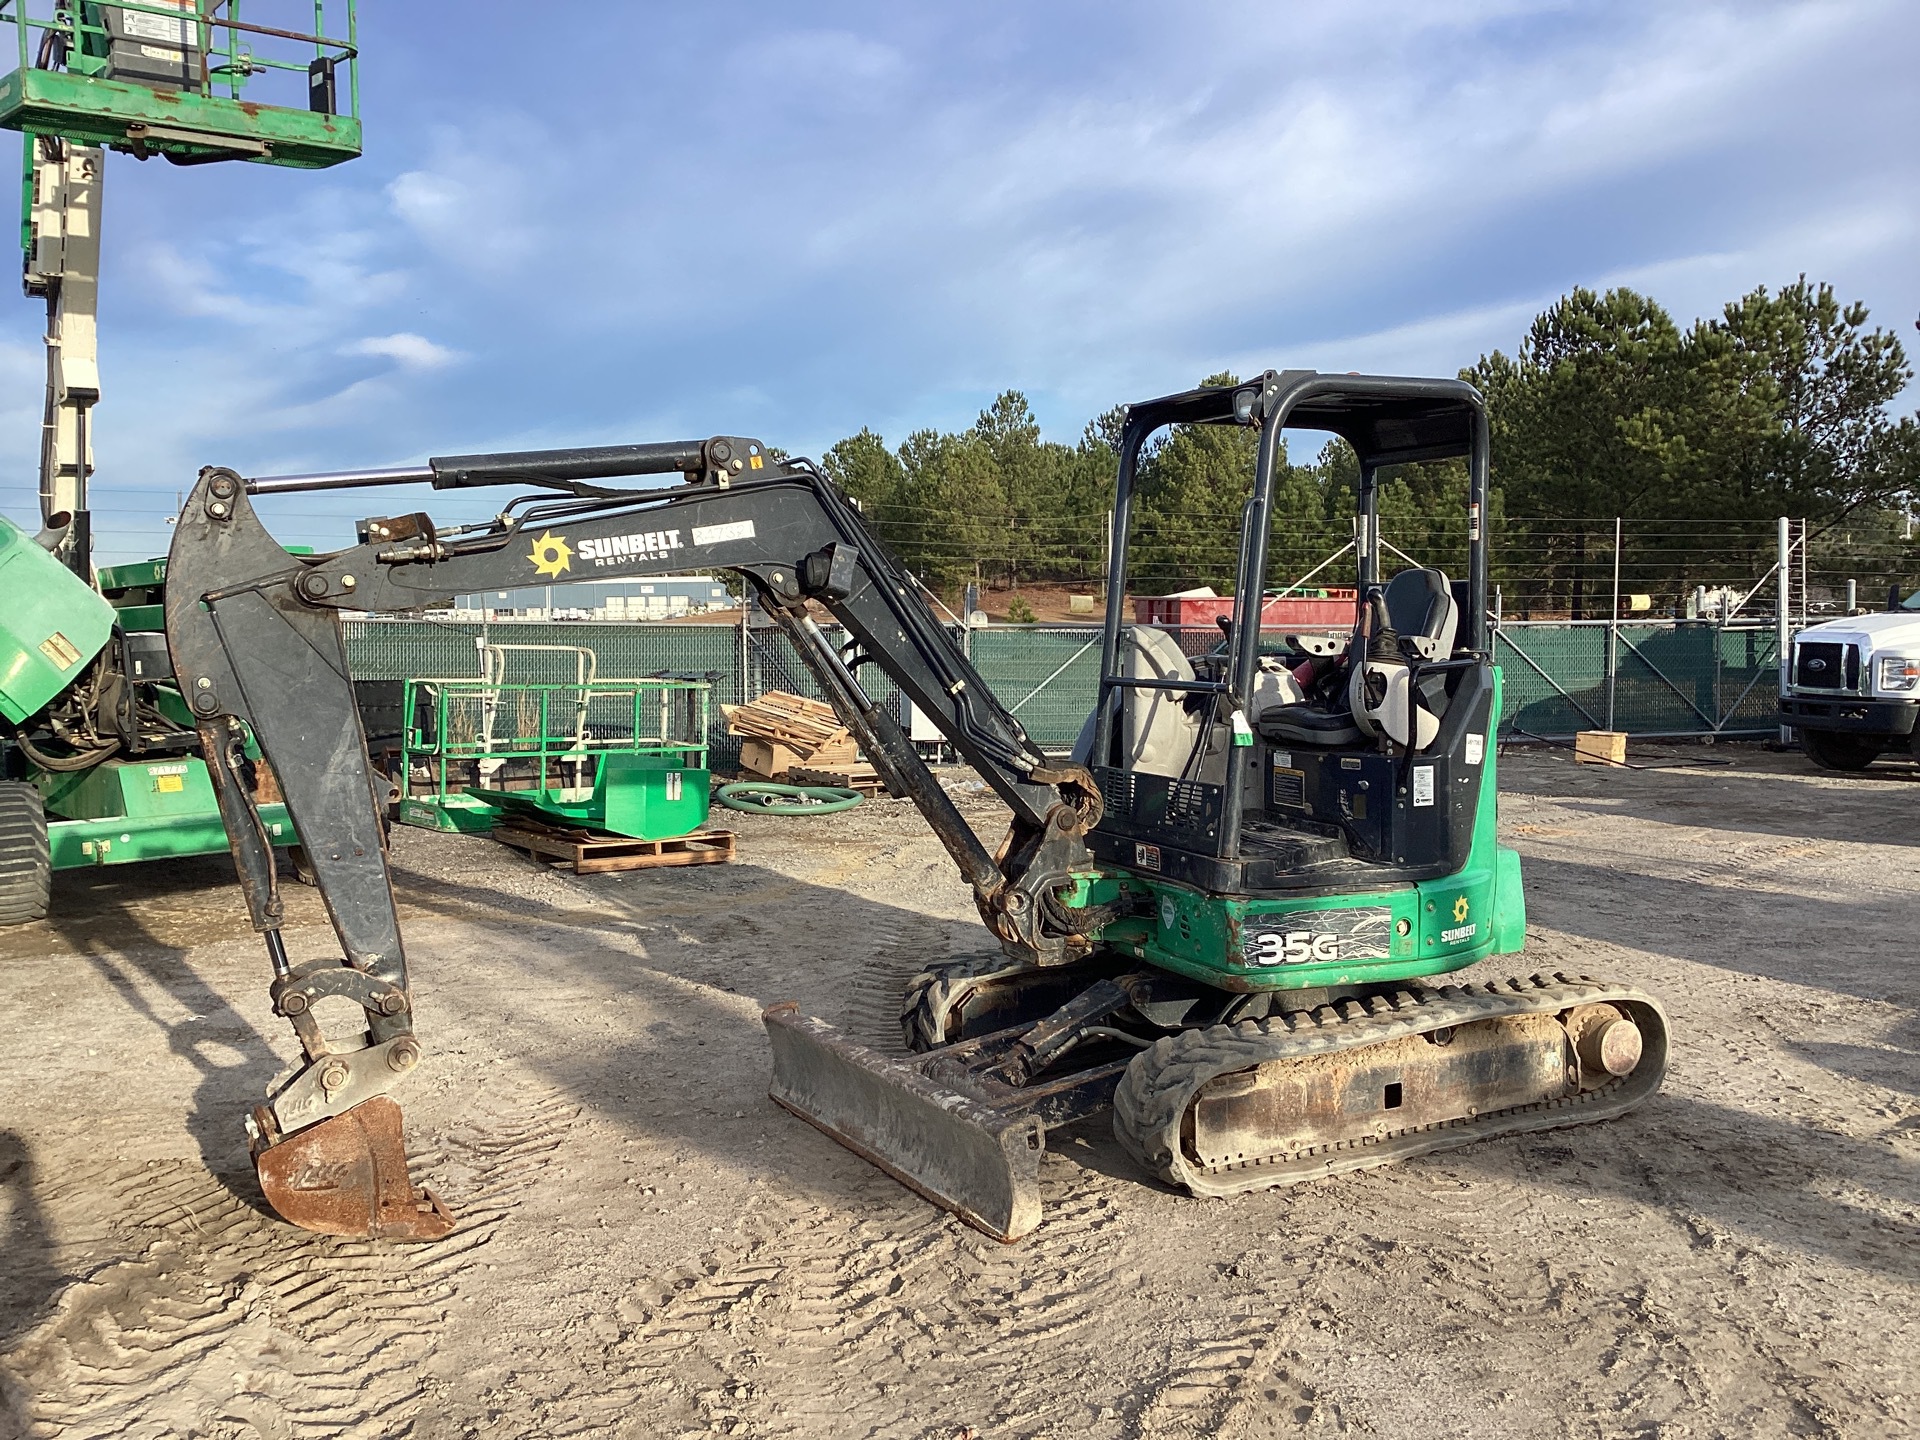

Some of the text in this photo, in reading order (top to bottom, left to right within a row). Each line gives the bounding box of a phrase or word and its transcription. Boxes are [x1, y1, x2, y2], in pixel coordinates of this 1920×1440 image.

[578, 529, 682, 560] SUNBELT
[594, 550, 669, 567] RENTALS
[1441, 923, 1477, 943] SUNBELT
[1257, 931, 1339, 965] 35G
